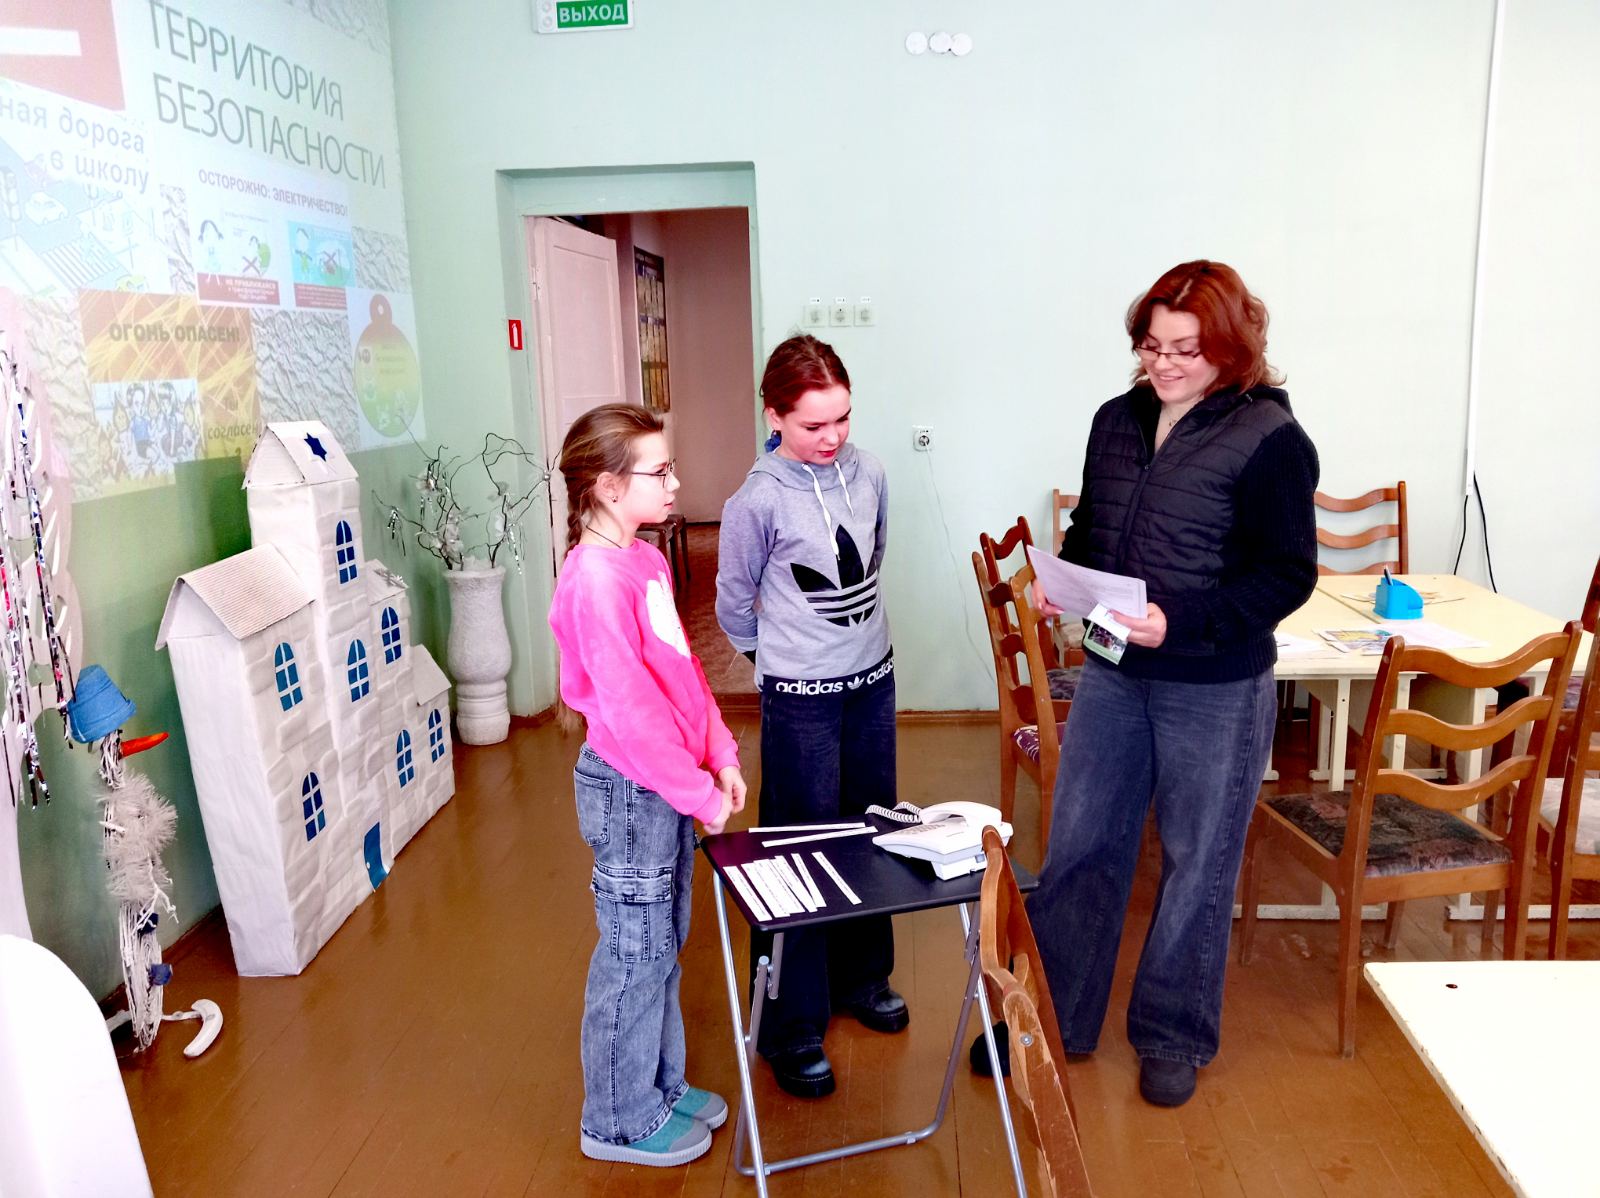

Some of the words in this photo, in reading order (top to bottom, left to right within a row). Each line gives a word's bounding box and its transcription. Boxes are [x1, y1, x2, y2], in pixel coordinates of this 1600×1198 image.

[559, 4, 625, 23] ВЫХОД
[149, 0, 345, 121] ТЕРРИТОРИЯ
[59, 106, 145, 154] дорога
[152, 72, 386, 189] БЕЗОПАСНОСТИ
[75, 155, 149, 194] школу
[198, 168, 272, 200] ОСТОРОЖНО:
[272, 187, 349, 217] ЭЛЕКТРИЧЕСТВО!
[109, 322, 171, 342] ОГОНЬ
[174, 325, 240, 342] ОПАСЕН!
[775, 680, 844, 695] adidas
